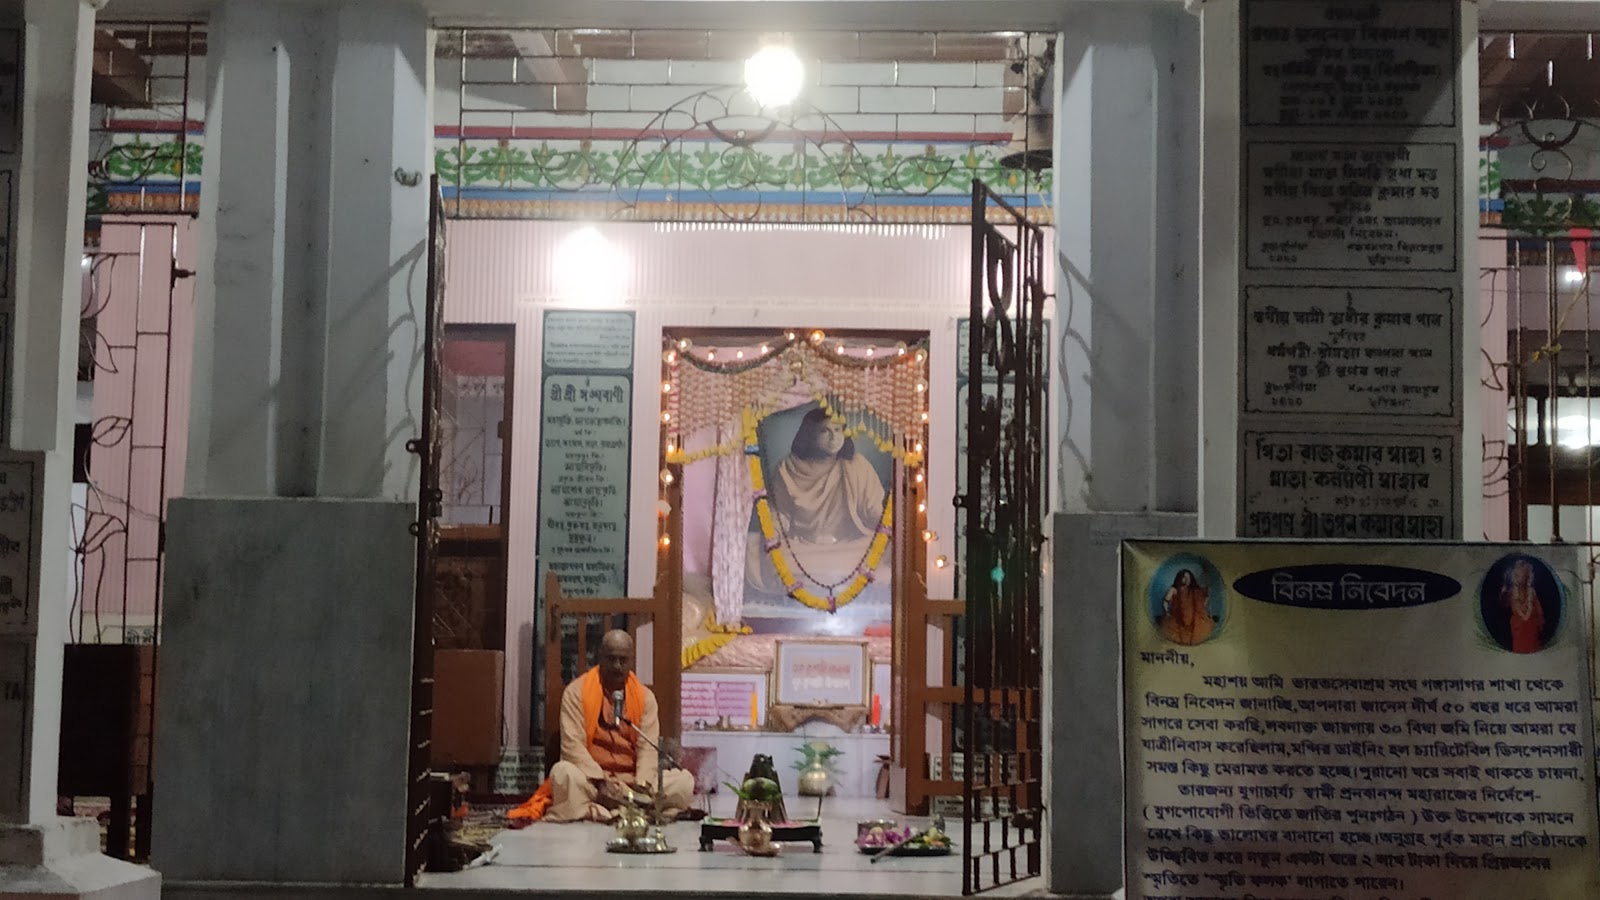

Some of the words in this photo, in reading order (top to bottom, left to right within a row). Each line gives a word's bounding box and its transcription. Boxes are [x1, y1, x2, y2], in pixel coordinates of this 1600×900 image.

[1256, 438, 1293, 462] পিতা
[1387, 445, 1425, 467] সাহা
[1271, 572, 1334, 601] বিনম্র
[1340, 572, 1426, 603] নিবেদন
[1141, 649, 1195, 668] মাননীয়,
[1202, 674, 1247, 688] মহাশয়
[1252, 674, 1283, 689] আমি
[1291, 677, 1385, 691] ভারতসেবাশ্রম
[1390, 679, 1417, 692] সংঘ
[1422, 679, 1484, 692] গঙ্গাসাগর
[1489, 679, 1521, 692] শাখা
[1526, 679, 1564, 692] থেকে
[1146, 692, 1179, 709] বিনম্র
[1184, 693, 1234, 710] নিবেদন
[1361, 700, 1407, 713] জানেন
[1412, 698, 1438, 713] দীর্ঘ
[1442, 704, 1464, 713] ৫০
[1470, 702, 1499, 714] বছর
[1505, 702, 1530, 713] ধরে
[1535, 700, 1578, 713] আমরা
[1141, 717, 1182, 730] সাগরে
[1188, 718, 1218, 731] সেবা
[1379, 724, 1402, 734] ৩০
[1408, 719, 1436, 735] বিঘা
[1441, 720, 1470, 735] জমি
[1475, 720, 1506, 735] নিয়ে
[1511, 722, 1553, 735] আমরা
[1559, 723, 1576, 735] যে
[1141, 735, 1211, 752] যাত্রীনিবাস
[1335, 741, 1385, 757] ডাইনিং
[1389, 744, 1409, 757] হল
[1495, 742, 1583, 758] ডিসপেনসারী
[1146, 761, 1179, 774] সমস্ত
[1183, 759, 1210, 778] কিছু
[1215, 763, 1268, 776] মেরামত
[1273, 764, 1314, 777] করতে
[1412, 767, 1439, 779] ঘরে
[1442, 765, 1480, 780] সবাই
[1485, 767, 1533, 780] থাকতে
[1538, 767, 1584, 782] চায়না,
[1178, 784, 1233, 797] তারজন্য
[1304, 783, 1335, 800] স্বামী
[1407, 789, 1477, 803] মহারাজের
[1239, 805, 1292, 821] ভিত্তিতে
[1296, 806, 1341, 822] জাতির
[1421, 808, 1452, 823] উক্ত
[1455, 808, 1525, 824] উদ্দেশ্যকে
[1529, 811, 1574, 824] সামনে
[1147, 827, 1181, 840] রেখে
[1186, 825, 1213, 843] কিছু
[1283, 830, 1334, 843] বানানো
[1469, 833, 1506, 847] মহান
[1511, 831, 1587, 850] প্রতিষ্ঠানকে
[1213, 850, 1243, 865] করে
[1286, 850, 1325, 866] একটা
[1362, 854, 1372, 867] ২
[1408, 852, 1440, 869] টাকা
[1445, 852, 1478, 869] দিয়ে
[1297, 875, 1349, 889] লাগাতে
